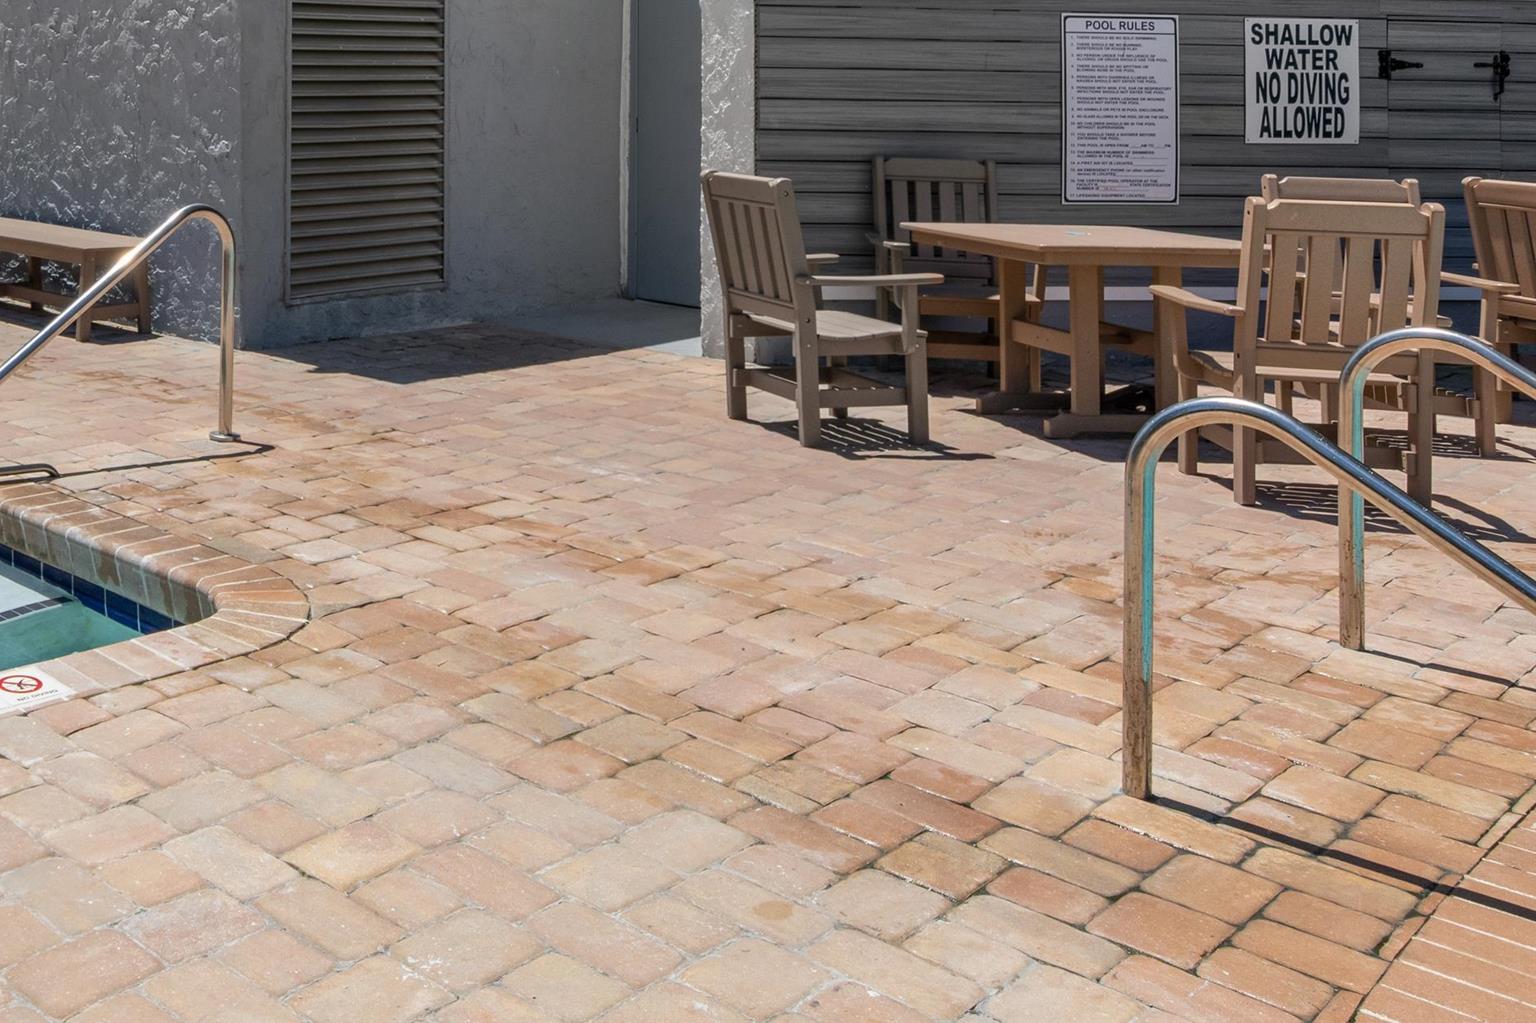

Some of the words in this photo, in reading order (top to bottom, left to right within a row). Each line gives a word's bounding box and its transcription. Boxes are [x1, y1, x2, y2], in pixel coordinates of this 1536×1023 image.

[1085, 20, 1116, 31] POOL
[1119, 21, 1155, 32] RULES
[1251, 23, 1353, 46] SHALLOW
[1265, 48, 1339, 70] WATER
[1256, 72, 1281, 104] NO
[1288, 72, 1350, 105] DIVING
[1259, 106, 1345, 139] ALLOWED
